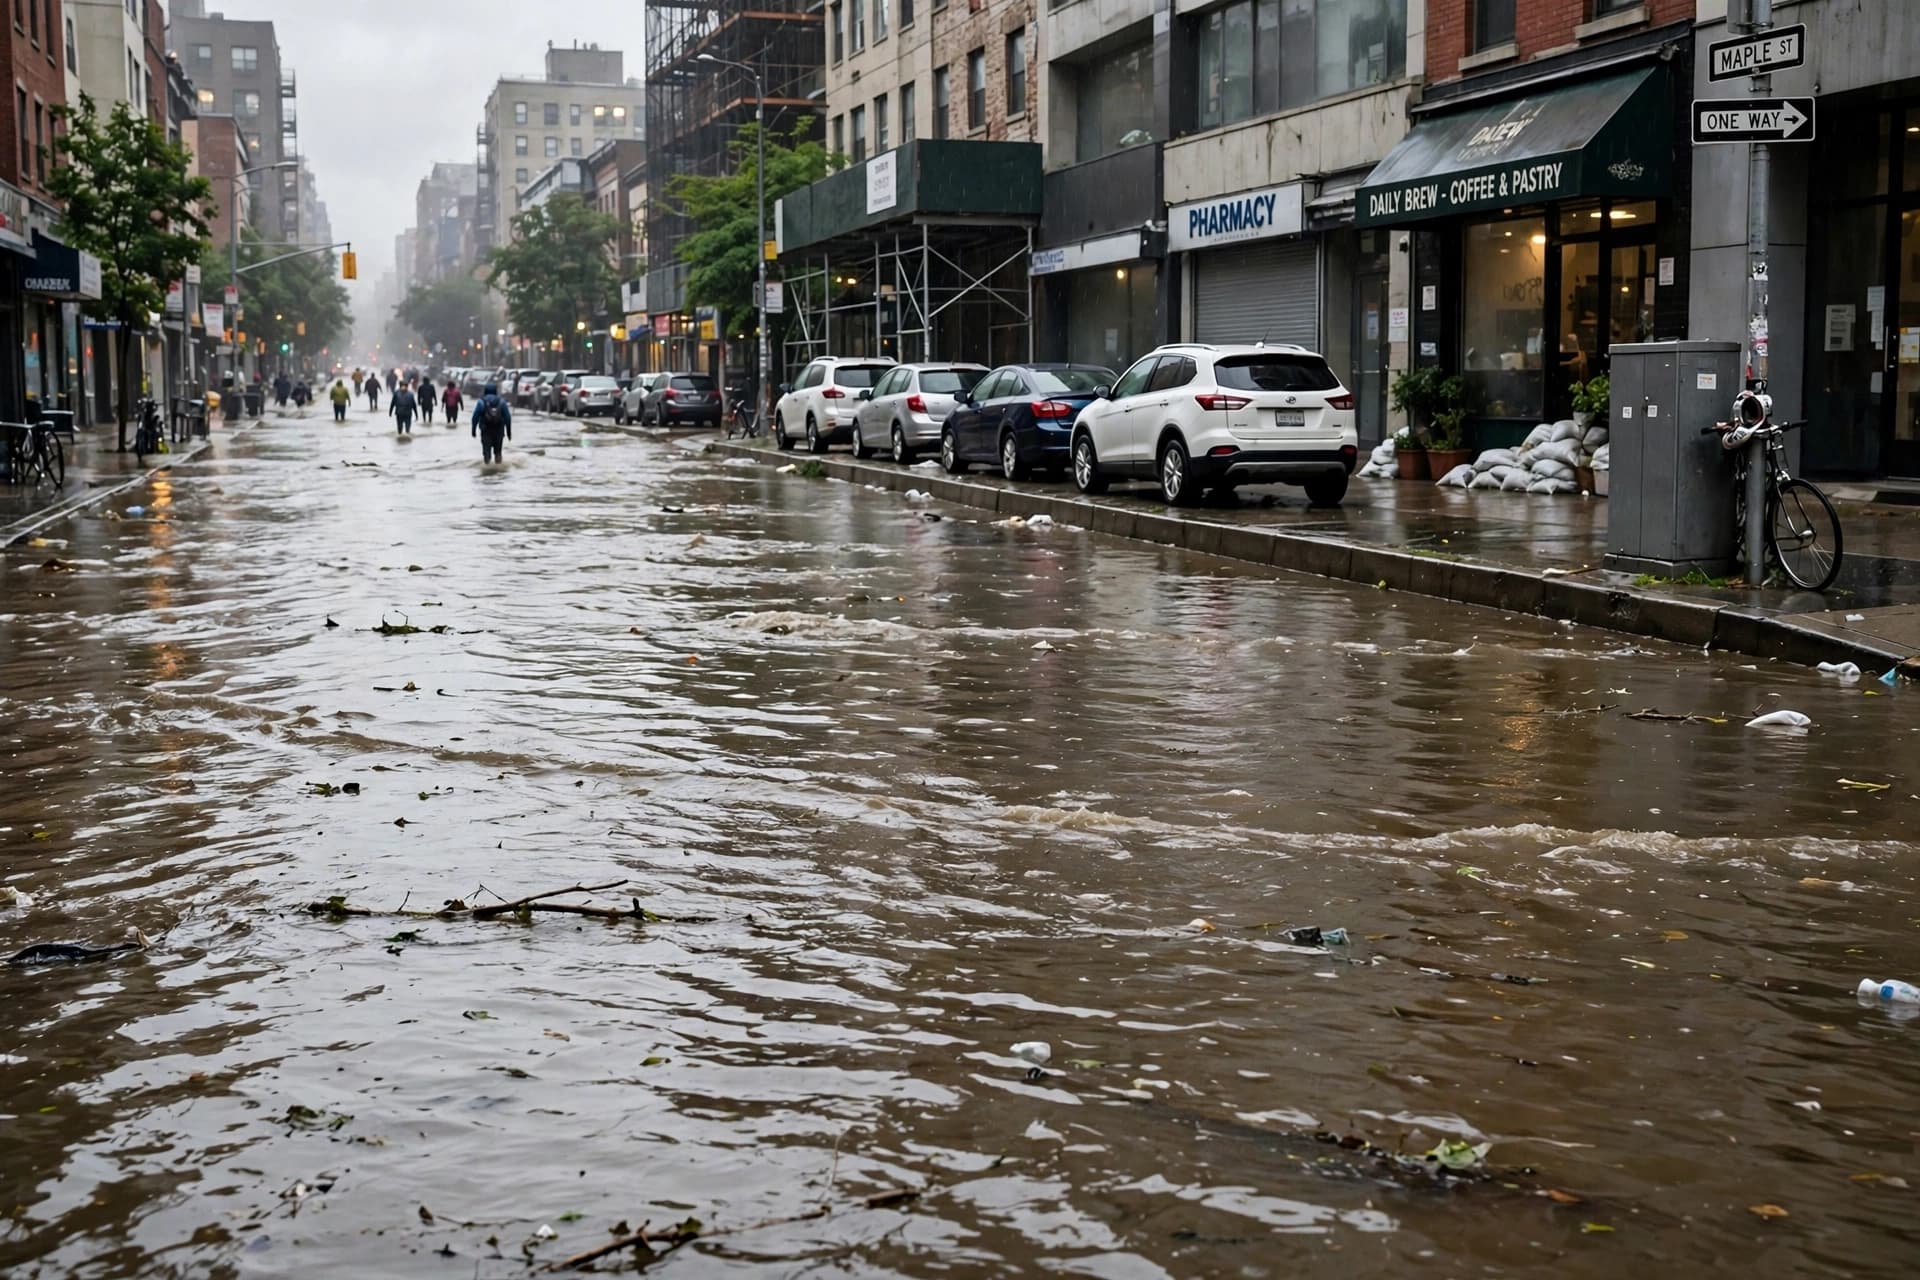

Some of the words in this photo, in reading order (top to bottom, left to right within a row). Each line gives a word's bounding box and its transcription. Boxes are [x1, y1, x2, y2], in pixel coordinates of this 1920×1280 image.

[1721, 42, 1772, 71] MAPLE
[1779, 39, 1793, 55] ST
[1707, 113, 1739, 130] ONE
[1748, 111, 1781, 129] WAY
[1369, 190, 1402, 217] DAILY
[1404, 184, 1438, 212] BREW
[1450, 174, 1496, 205] COFFEE
[1499, 172, 1509, 197] &
[1512, 162, 1563, 195] PASTRY
[1189, 193, 1276, 239] PHARMACY
